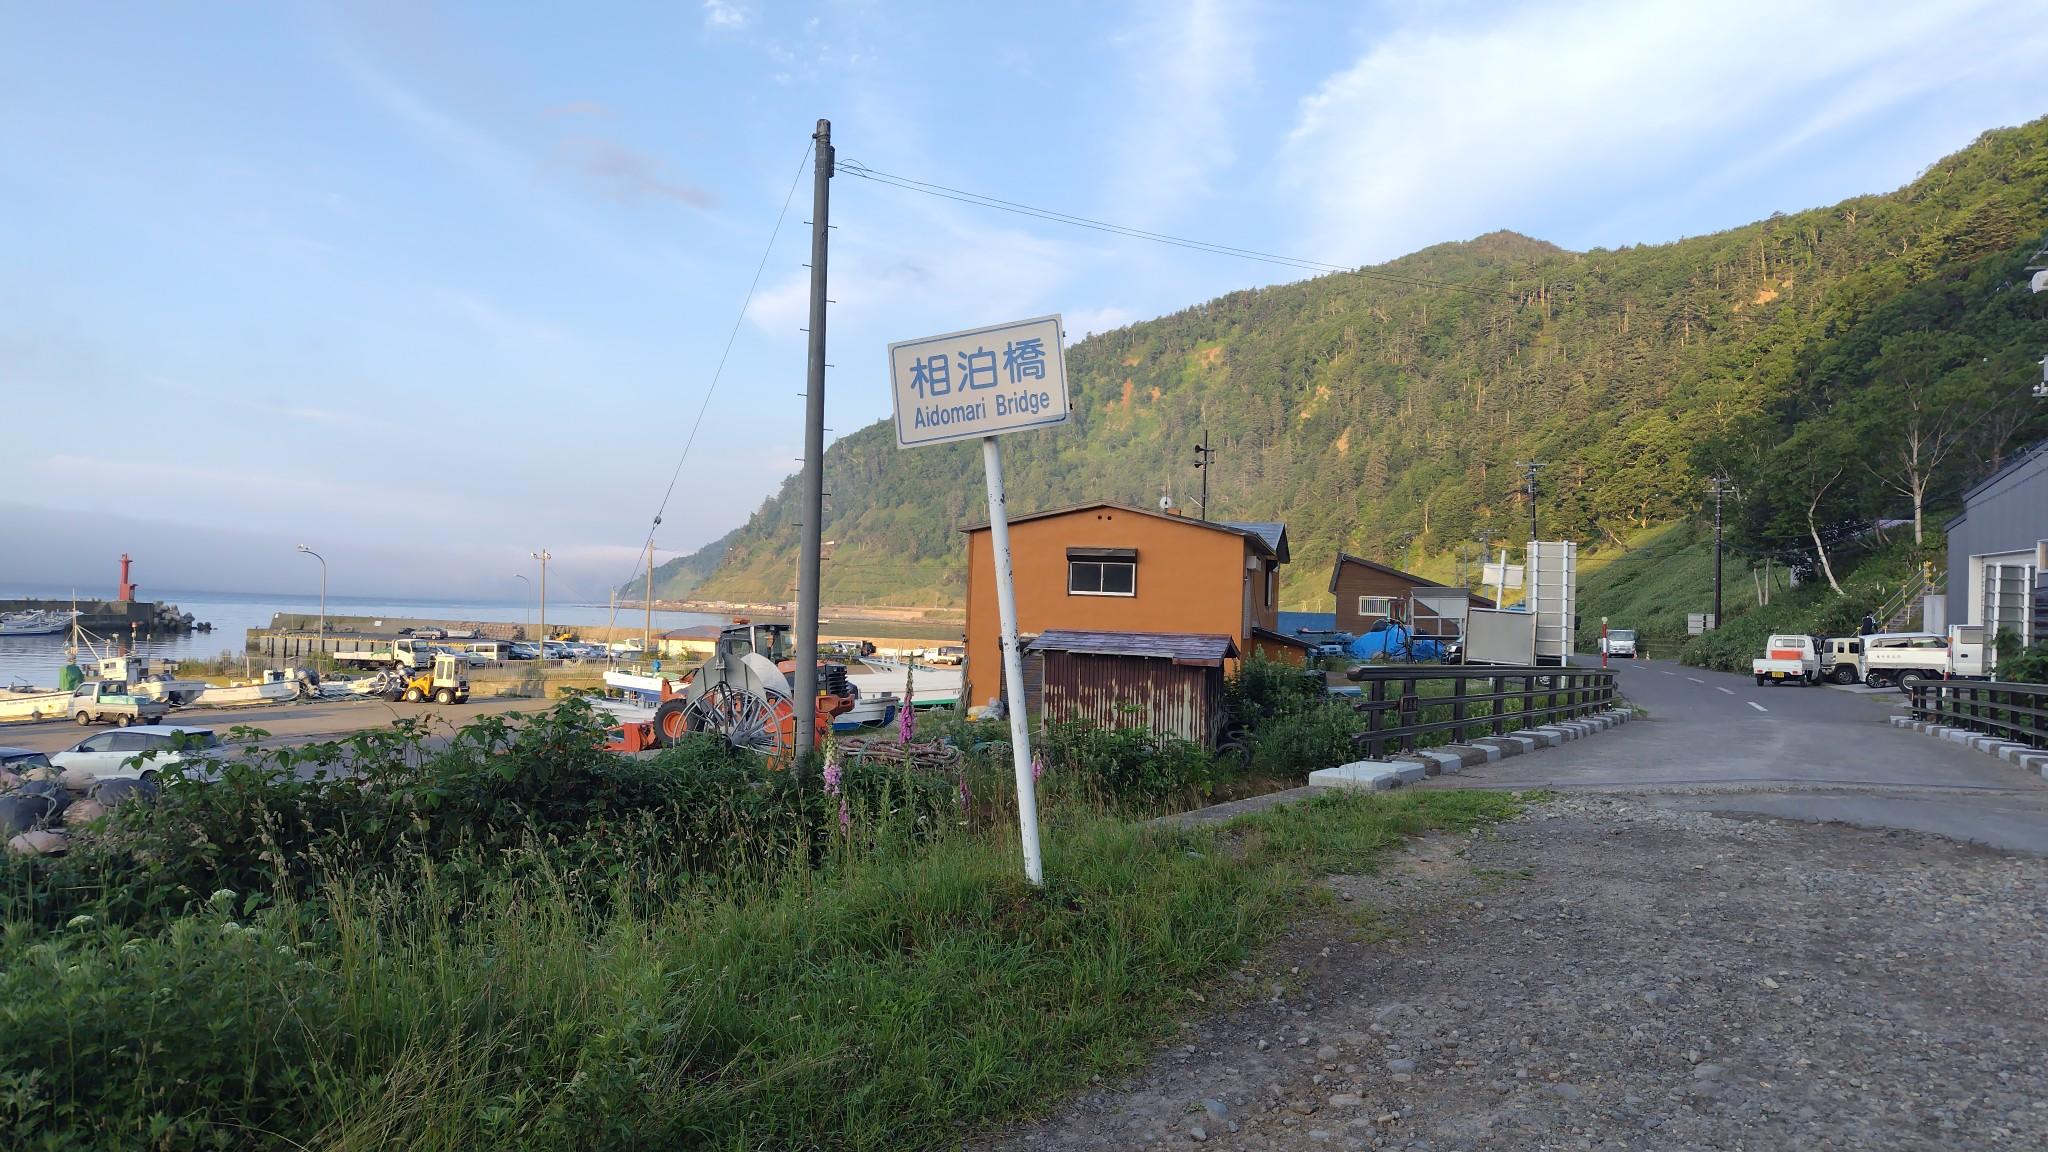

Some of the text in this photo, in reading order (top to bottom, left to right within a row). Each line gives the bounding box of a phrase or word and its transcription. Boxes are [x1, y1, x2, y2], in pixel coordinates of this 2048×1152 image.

[910, 337, 1047, 399] 相泊橋
[914, 390, 1050, 429] Aidomari Bridge
